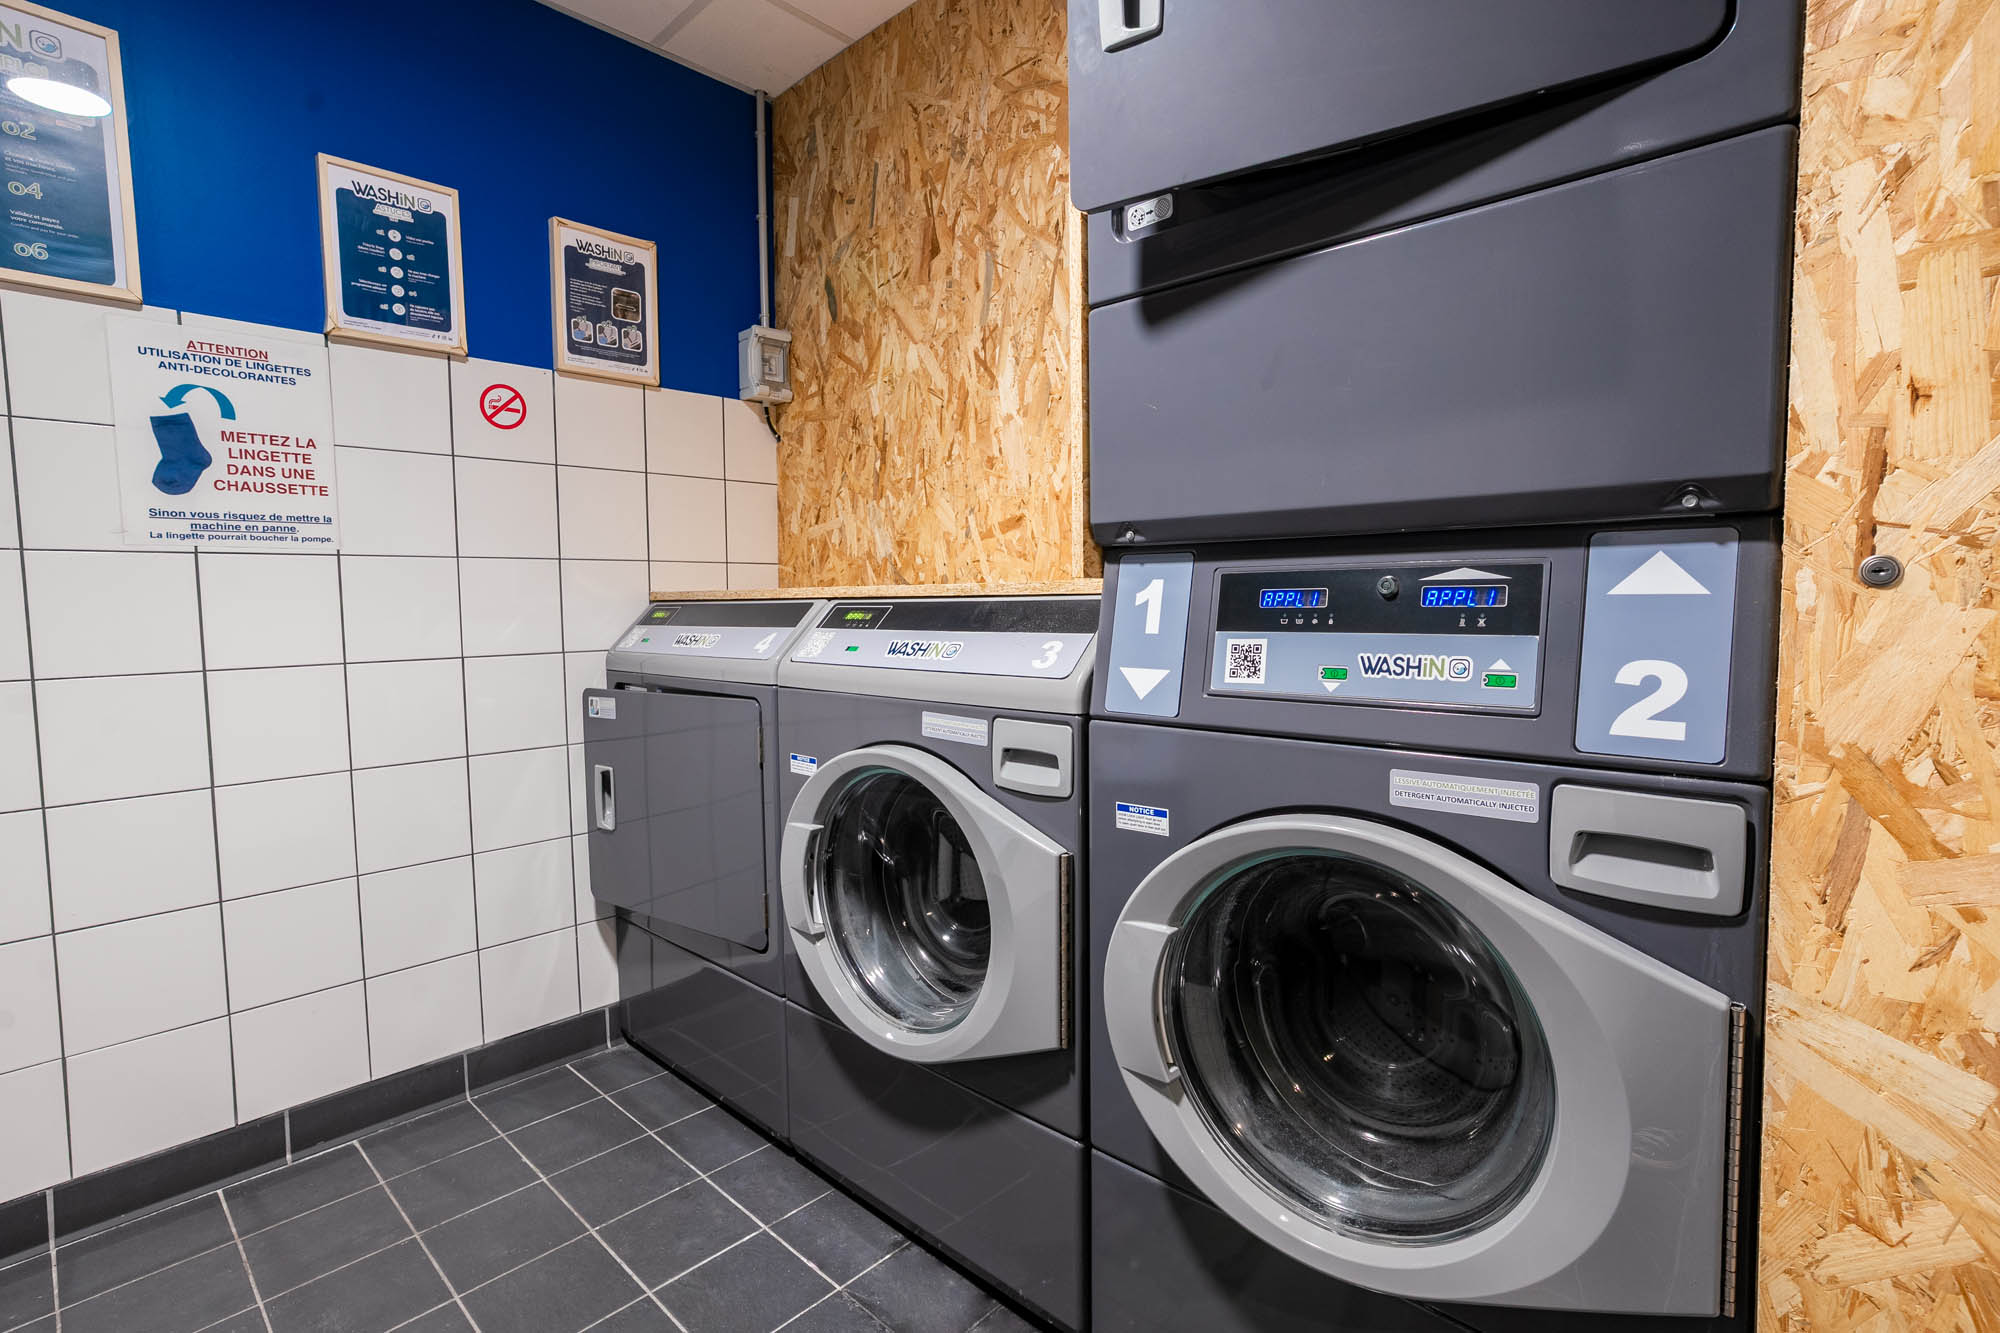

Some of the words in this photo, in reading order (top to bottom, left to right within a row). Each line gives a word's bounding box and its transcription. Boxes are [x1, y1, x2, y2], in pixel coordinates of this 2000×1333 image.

[1, 120, 37, 141] 02
[8, 181, 43, 200] 04
[376, 204, 411, 218] ASTUCES
[14, 242, 48, 261] 06
[186, 340, 269, 360] ATTENTION
[137, 346, 221, 365] UTILISATION
[224, 357, 242, 368] DE
[246, 360, 311, 377] LINGETTES
[158, 361, 296, 386] ANTI-DECOLORANTES
[220, 430, 291, 447] METTEZ
[295, 438, 317, 450] LA
[228, 448, 312, 465] LINGETTE
[226, 464, 276, 478] DANS
[280, 468, 316, 481] UNE
[214, 479, 329, 497] CHAUSSETTE
[148, 508, 186, 518] Sinon
[190, 511, 219, 519] vous
[223, 510, 265, 522] risquez
[269, 512, 282, 521] de
[286, 514, 320, 522] mettre
[323, 515, 332, 523] la
[149, 531, 162, 539] La
[166, 532, 204, 542] lingette
[208, 533, 247, 543] pourrait
[250, 534, 288, 542] boucher
[290, 534, 299, 542] la
[302, 536, 334, 545] pompe.
[190, 522, 241, 532] machine
[262, 524, 300, 535] panne.
[1134, 578, 1164, 634] 1
[753, 631, 778, 653] 4
[1031, 640, 1064, 669] 3
[1609, 658, 1689, 741] 2
[1394, 777, 1420, 787] LESSIVE
[1422, 780, 1499, 795] AUTOMATIQUEMENT
[1128, 806, 1156, 816] NOTICE
[1394, 790, 1435, 802] DETERGENT
[1436, 796, 1497, 809] AUTOMATICALLY
[1498, 802, 1536, 813] INJECTED
